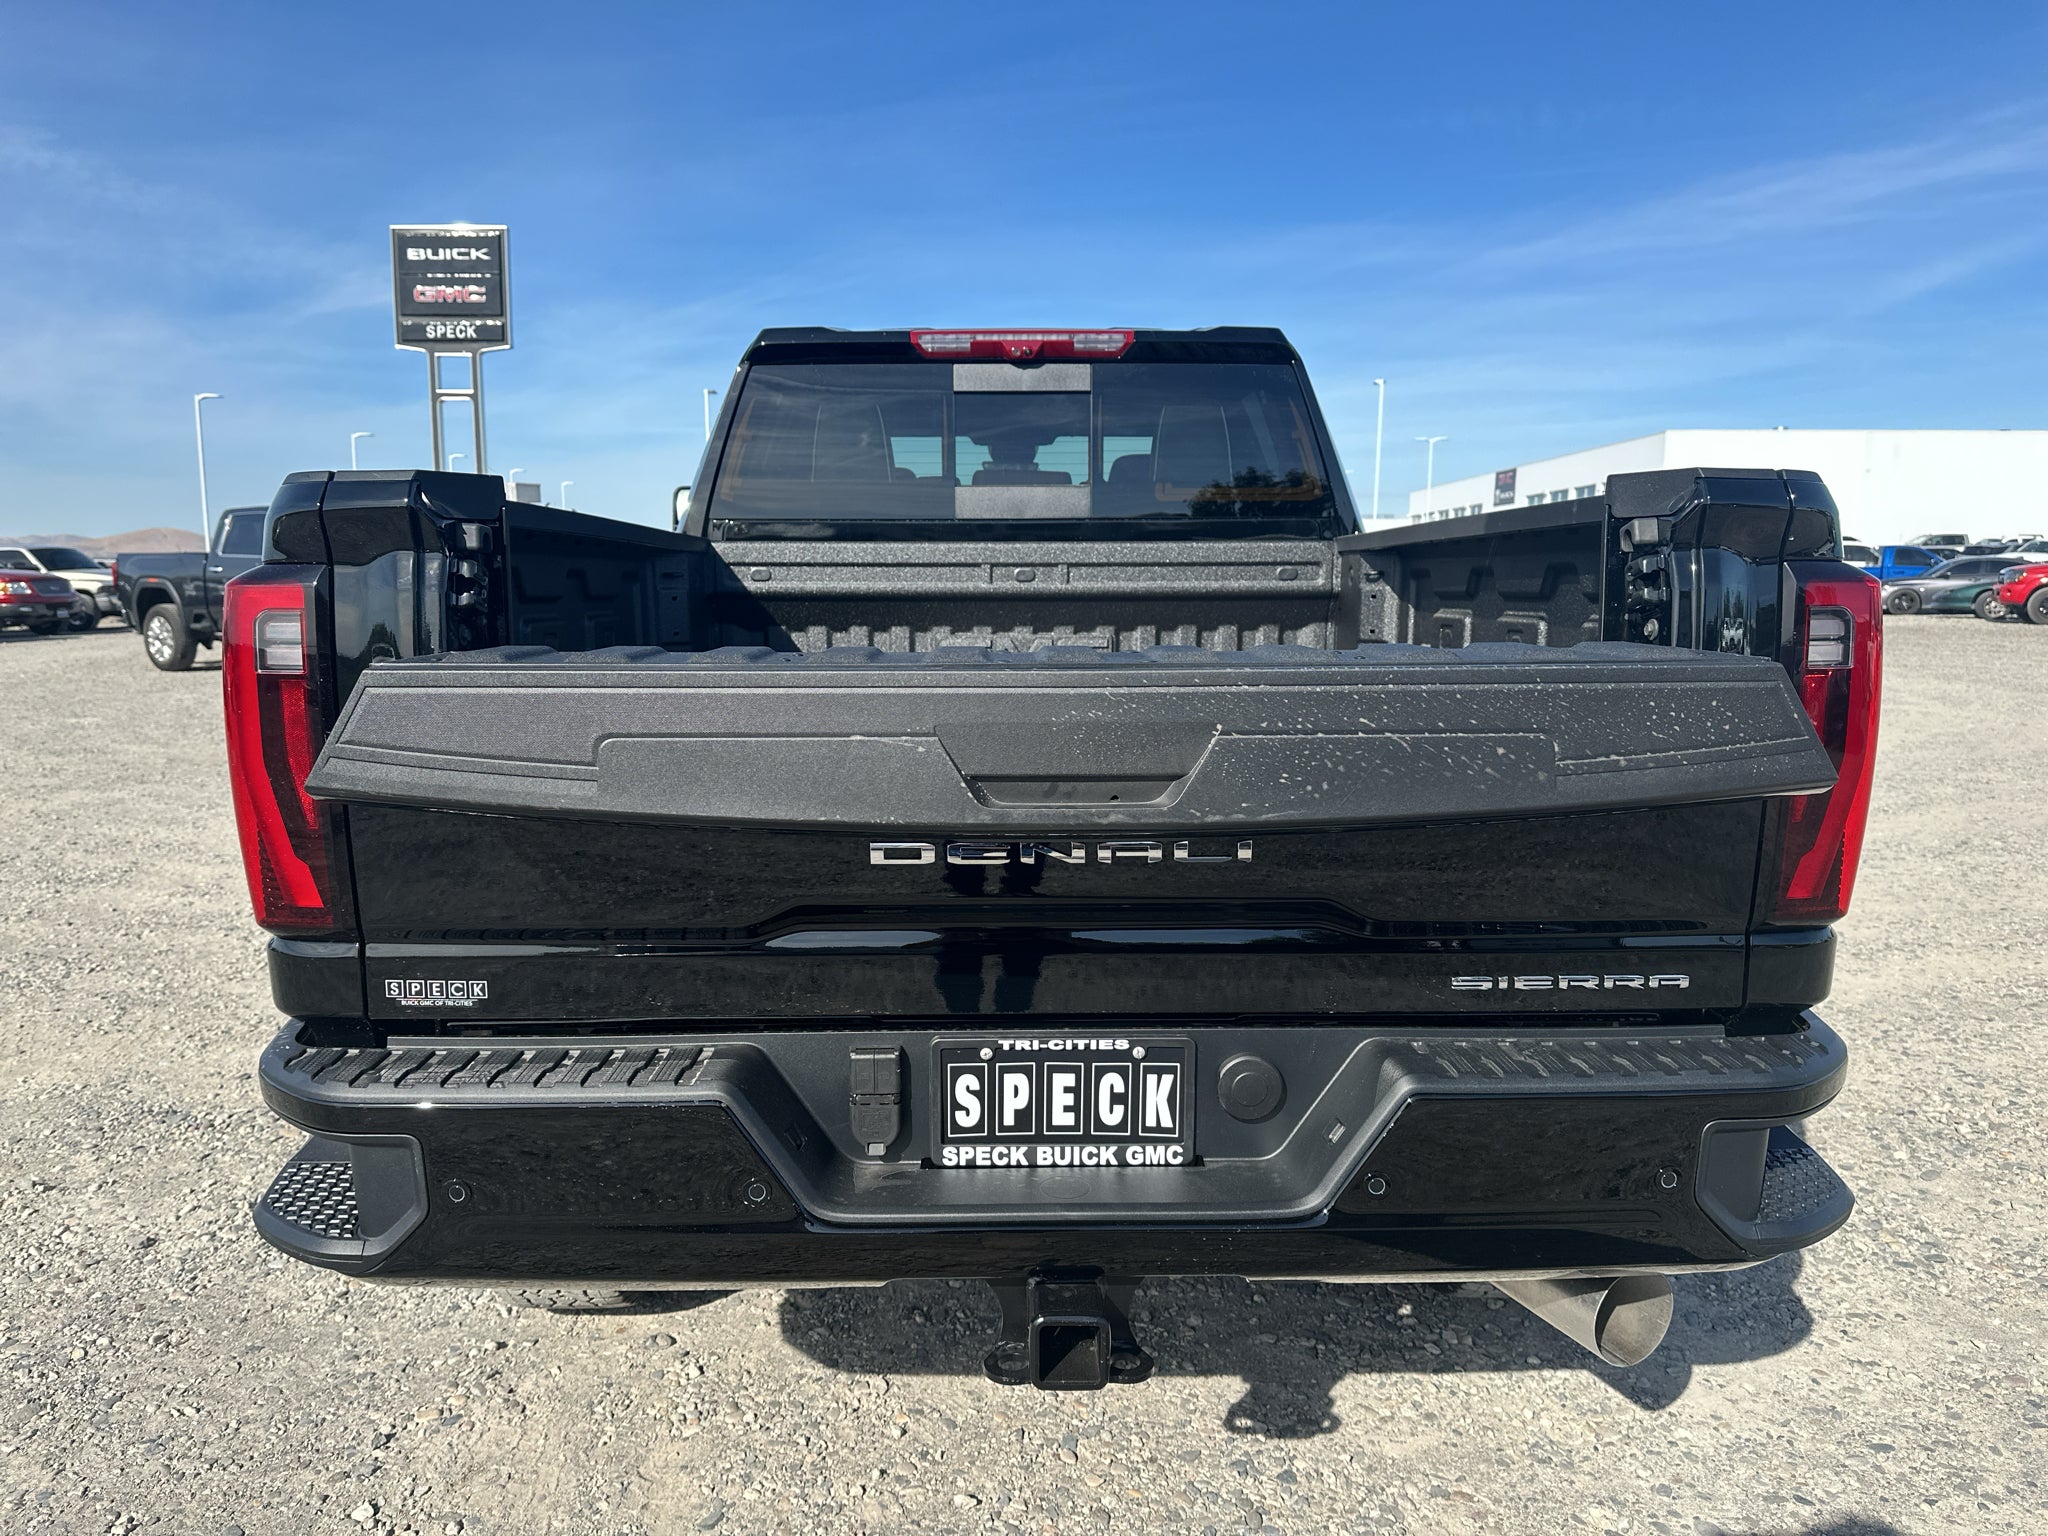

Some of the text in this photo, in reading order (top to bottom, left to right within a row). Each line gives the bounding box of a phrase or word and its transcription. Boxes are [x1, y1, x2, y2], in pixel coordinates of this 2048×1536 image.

[406, 248, 491, 260] BUICK
[413, 285, 486, 303] GMC
[426, 325, 477, 339] SPECK
[869, 840, 1253, 865] DENALI
[389, 982, 484, 997] SPECK
[1451, 974, 1690, 990] SIERRA
[998, 1039, 1130, 1050] TRI-CITIES
[954, 1072, 1174, 1128] SPECK
[942, 1146, 1184, 1166] SPECK BUICK GMC
